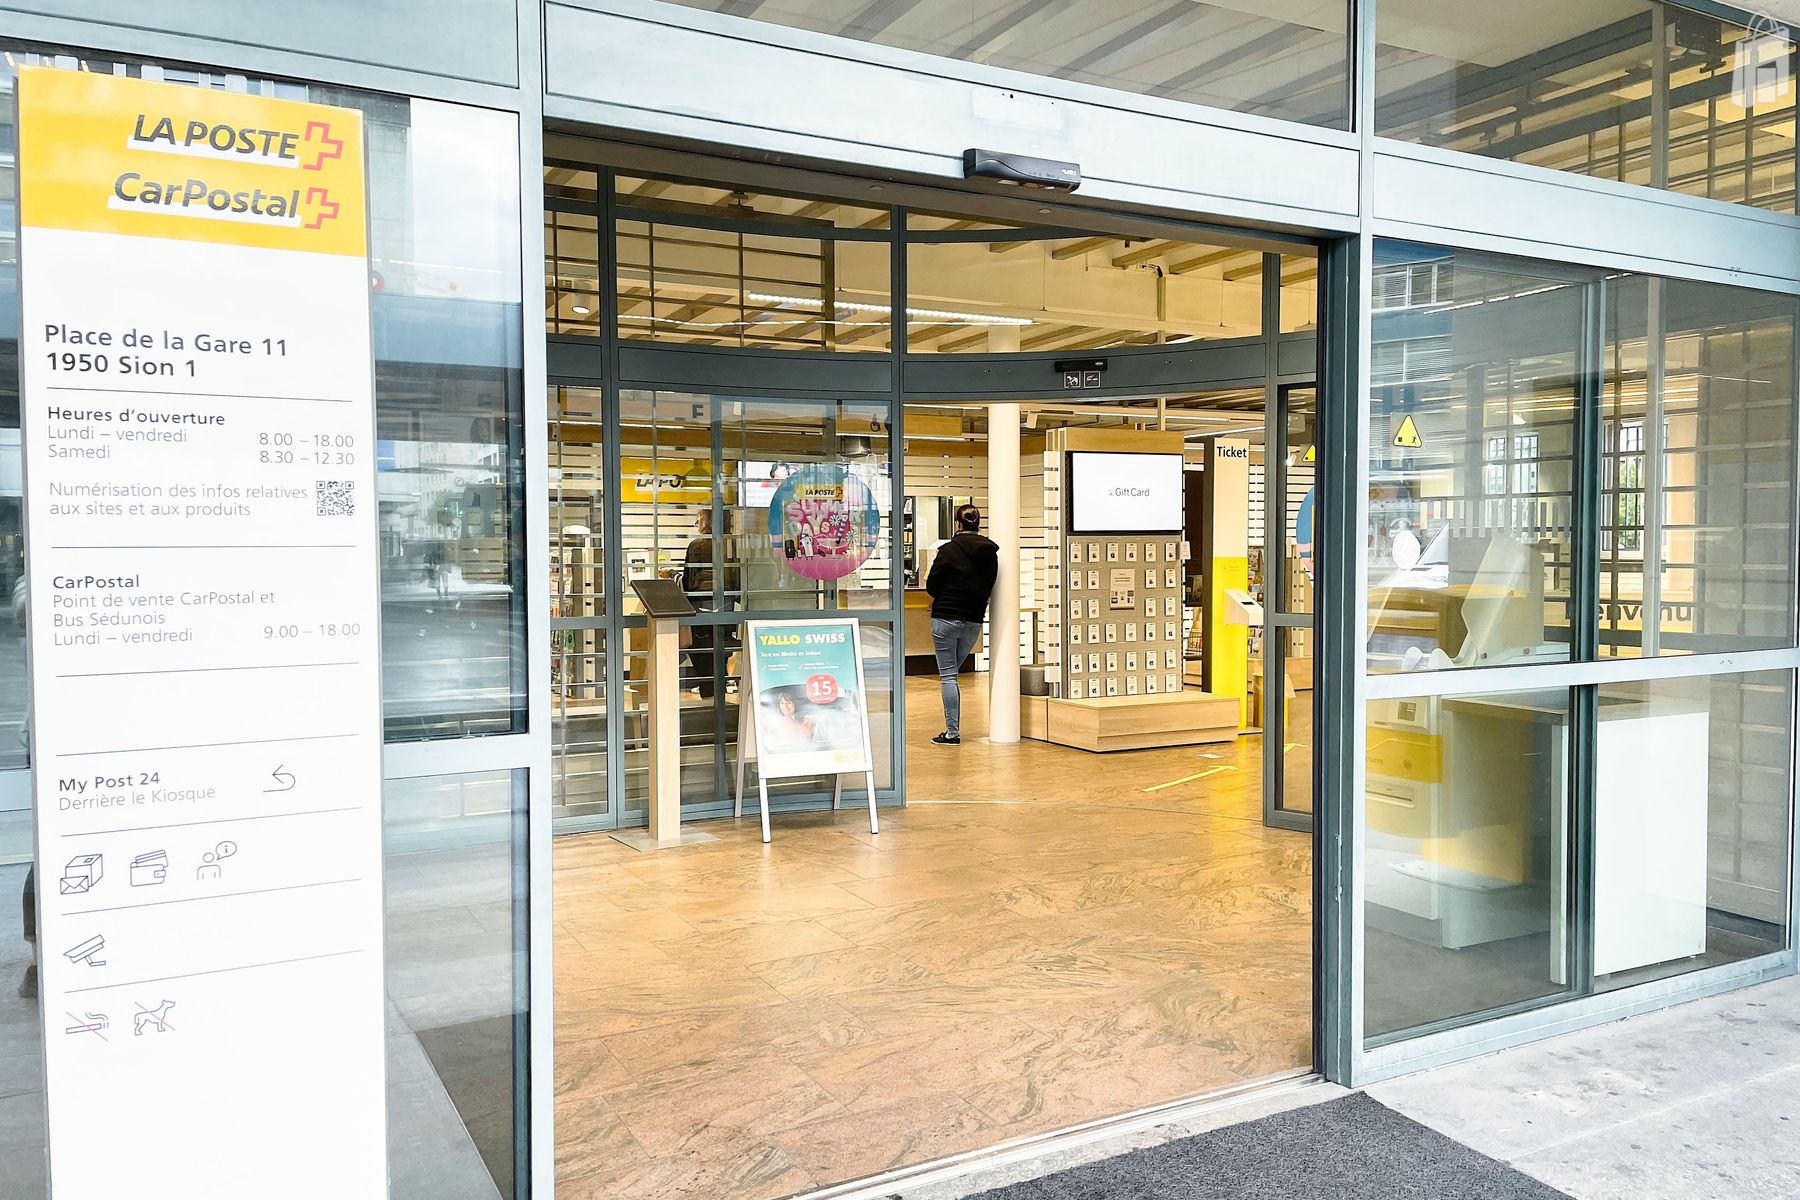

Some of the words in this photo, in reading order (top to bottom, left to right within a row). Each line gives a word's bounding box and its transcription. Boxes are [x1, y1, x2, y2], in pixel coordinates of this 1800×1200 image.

[133, 115, 176, 145] LA
[184, 121, 299, 159] POSTE
[114, 172, 299, 218] CarPostal
[46, 324, 112, 345] Place
[123, 329, 153, 348] de
[164, 331, 183, 350] la
[195, 334, 251, 354] Gare
[263, 339, 285, 356] 11
[48, 353, 108, 372] 1950
[119, 356, 173, 375] Sion
[186, 360, 194, 377] 1
[48, 407, 112, 421] Heures
[49, 426, 93, 439] Lundi
[116, 428, 186, 442] vendredi
[260, 433, 292, 445] 8.00
[314, 435, 353, 447] 18.00
[49, 444, 109, 458] Samedi
[260, 451, 293, 463] 8.30
[315, 452, 354, 464] 12.30
[1217, 446, 1247, 458] Ticket
[50, 483, 162, 496] Numérisation
[169, 484, 196, 497] des
[203, 484, 240, 497] infos
[246, 485, 307, 499] relatives
[1115, 487, 1130, 497] Gift
[1130, 487, 1150, 497] Card
[50, 504, 80, 515] aux
[87, 501, 122, 515] sites
[129, 504, 144, 515] et
[151, 505, 179, 515] aux
[186, 503, 250, 518] produits
[53, 575, 139, 588] CarPostal
[54, 595, 96, 608] Point
[103, 594, 122, 607] de
[129, 596, 174, 606] vente
[181, 591, 254, 605] CarPostal
[261, 593, 273, 603] et
[54, 614, 83, 627] Bus
[90, 612, 165, 626] Sédunois
[55, 631, 99, 645] Lundi
[122, 628, 192, 643] vendredi
[264, 625, 298, 638] 9.00
[320, 624, 360, 636] 18.00
[760, 634, 800, 646] YALLO
[804, 633, 846, 644] SWISS
[812, 681, 832, 696] 15
[60, 779, 87, 793] My
[96, 776, 132, 788] Post
[140, 772, 160, 785] 24
[59, 794, 127, 811] Derrière
[132, 791, 145, 804] le
[152, 789, 215, 803] Kiosque
